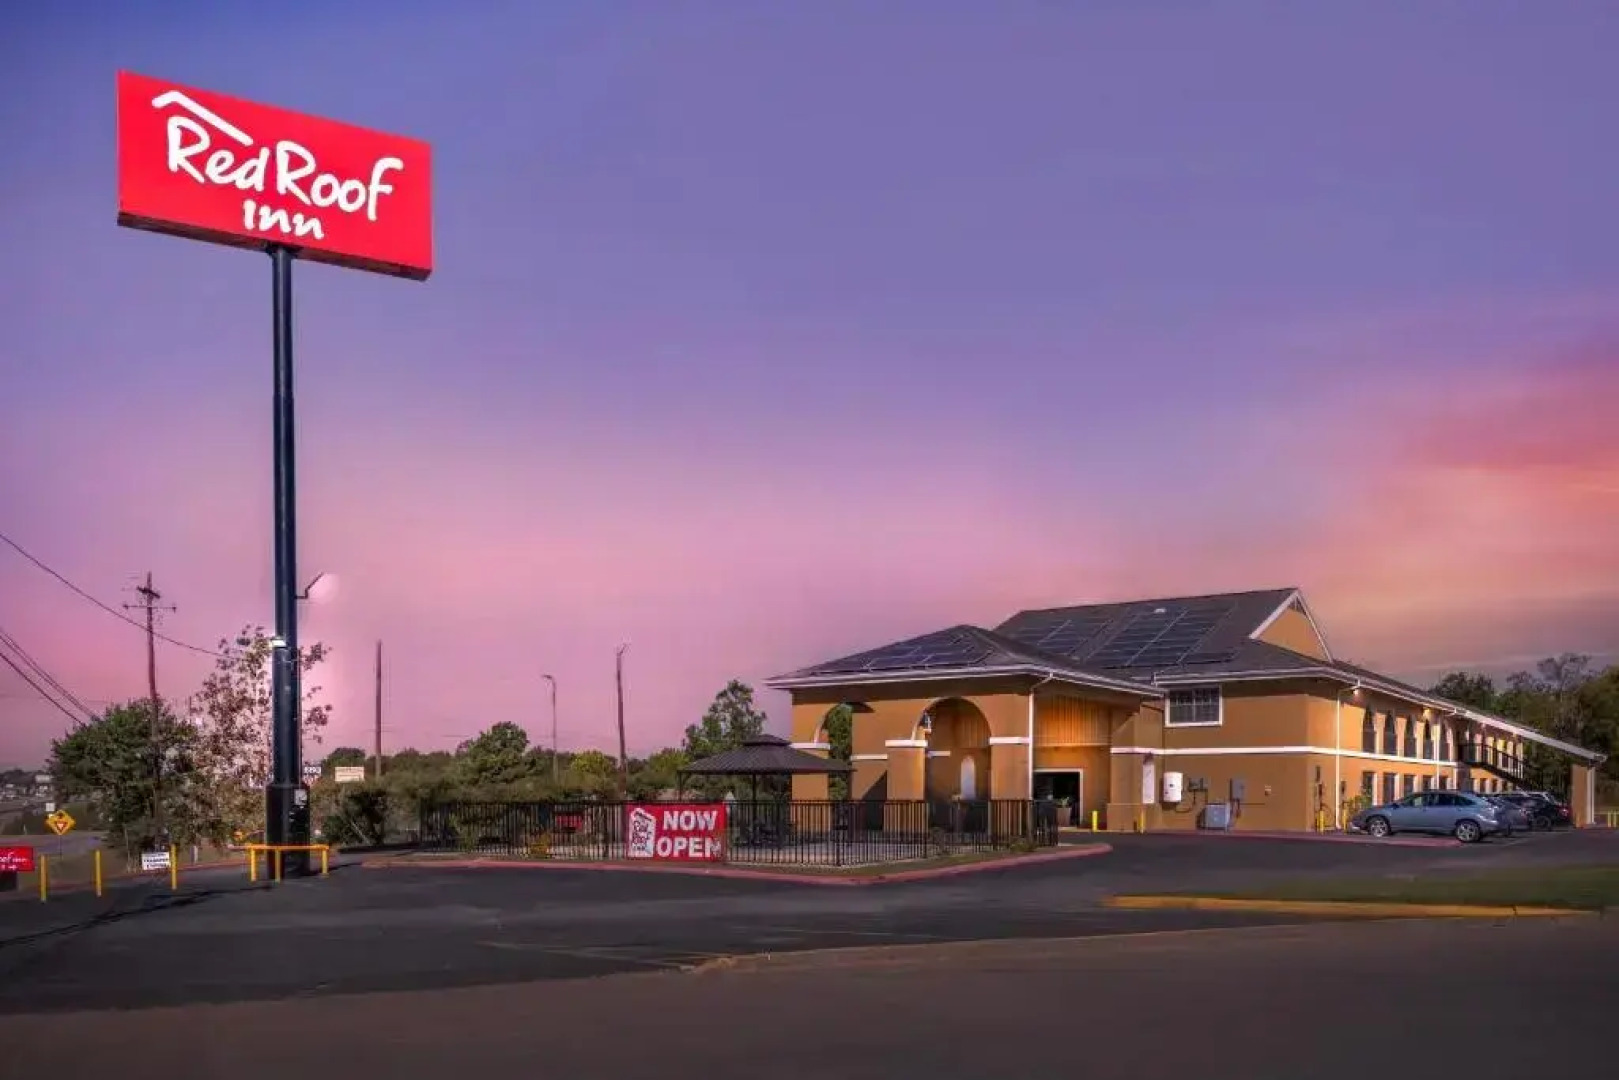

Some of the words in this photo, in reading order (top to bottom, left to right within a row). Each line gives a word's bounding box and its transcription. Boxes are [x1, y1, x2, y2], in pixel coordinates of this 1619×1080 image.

[167, 115, 270, 192] Red
[276, 140, 404, 221] Roof
[663, 810, 718, 831] NOW
[656, 836, 722, 858] OPEN
